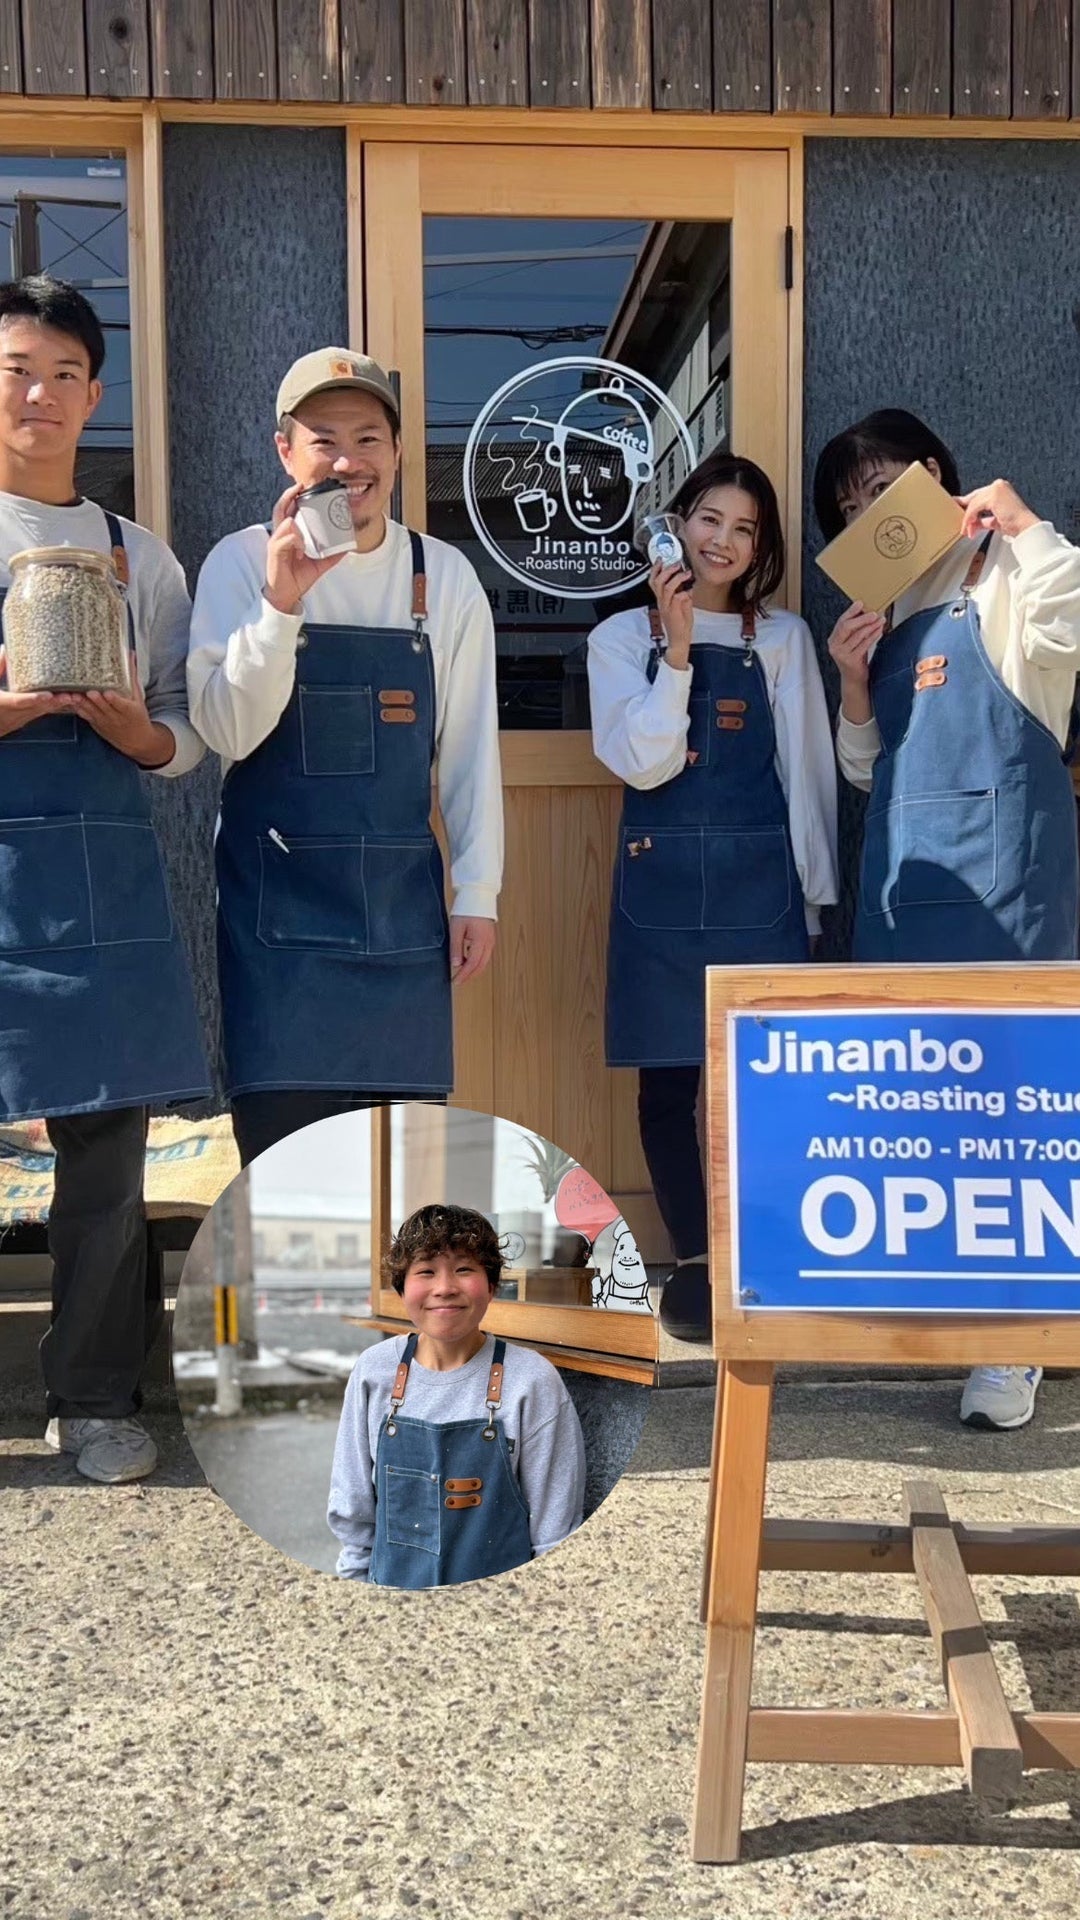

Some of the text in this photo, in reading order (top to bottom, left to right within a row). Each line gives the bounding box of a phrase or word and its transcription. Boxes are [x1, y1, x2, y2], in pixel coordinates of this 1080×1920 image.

[532, 536, 631, 555] Jinanbo
[518, 556, 643, 574] ~Roasting Studio~
[750, 1029, 984, 1074] Jinanbo
[806, 1137, 932, 1160] AM10:00
[959, 1138, 1080, 1162] PM17:00
[801, 1174, 1080, 1257] OPEN
